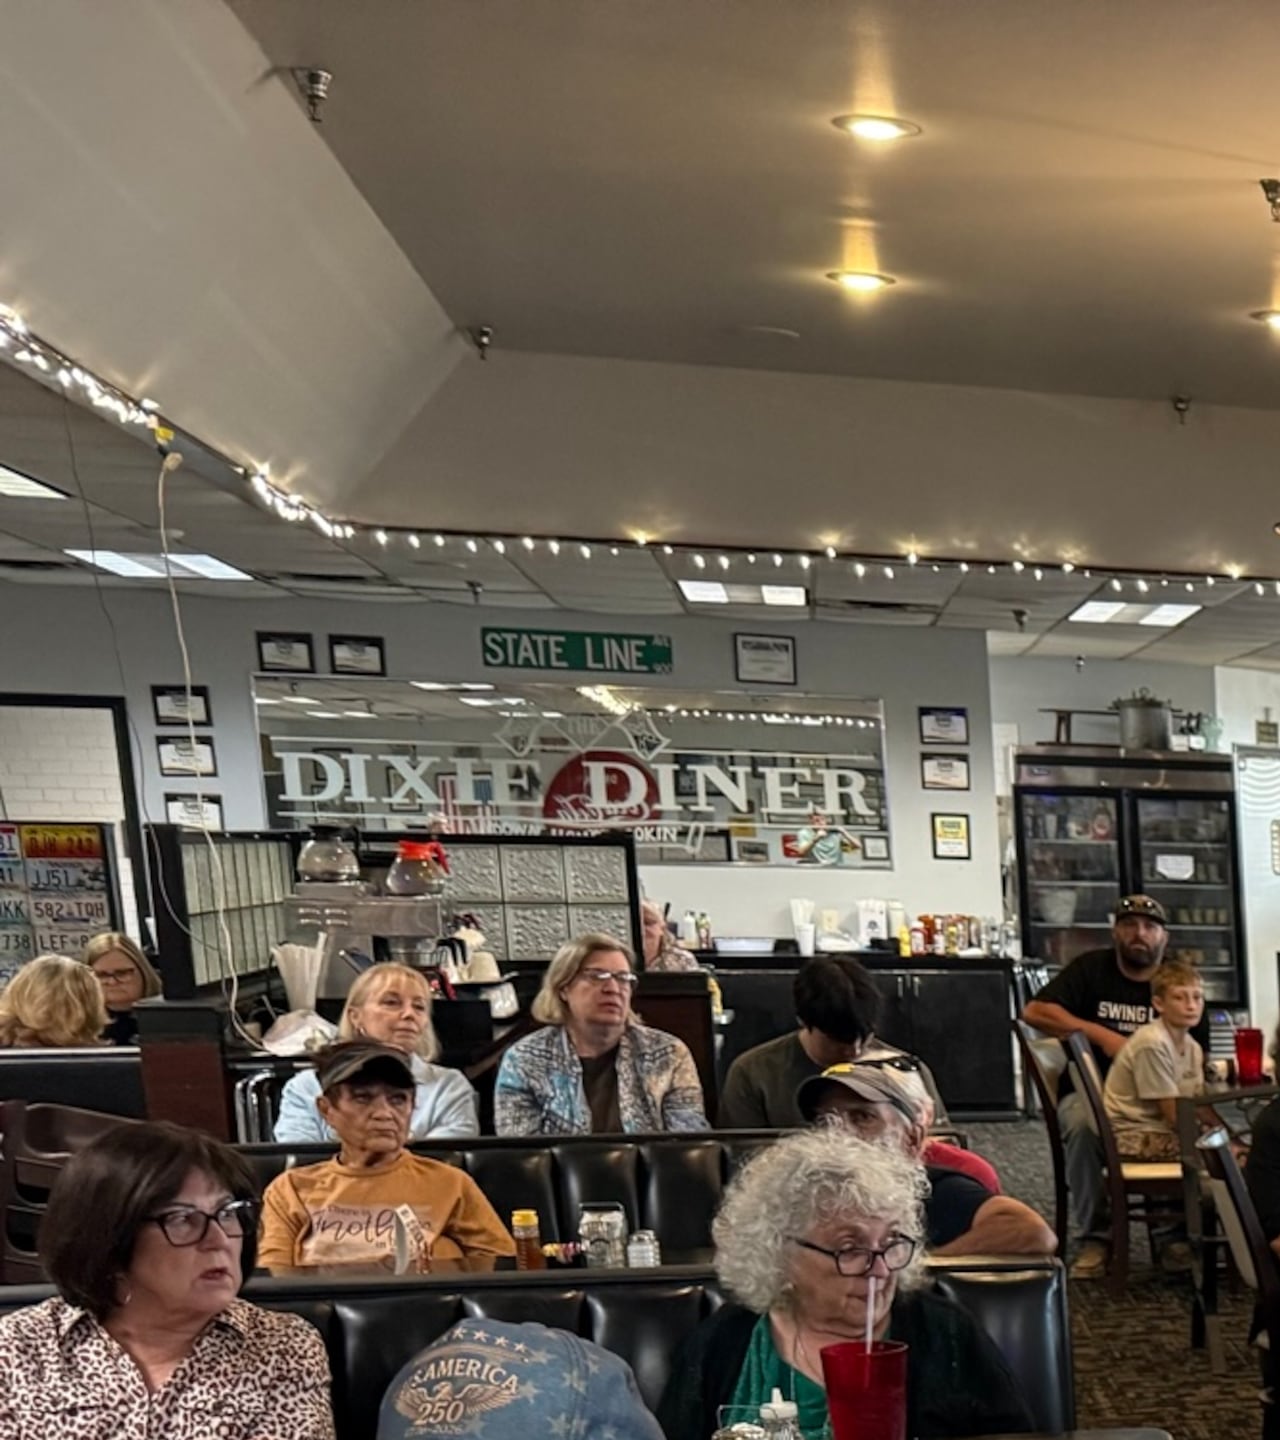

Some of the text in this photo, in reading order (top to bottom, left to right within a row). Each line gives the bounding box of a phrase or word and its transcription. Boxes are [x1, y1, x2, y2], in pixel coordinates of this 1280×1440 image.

[484, 632, 649, 671] STATE LINE
[274, 752, 544, 807] DIXIE
[581, 761, 876, 816] DINER
[34, 902, 65, 919] 582
[1097, 1001, 1147, 1022] SWING
[424, 1358, 519, 1394] AMERICA
[413, 1400, 465, 1426] 250
